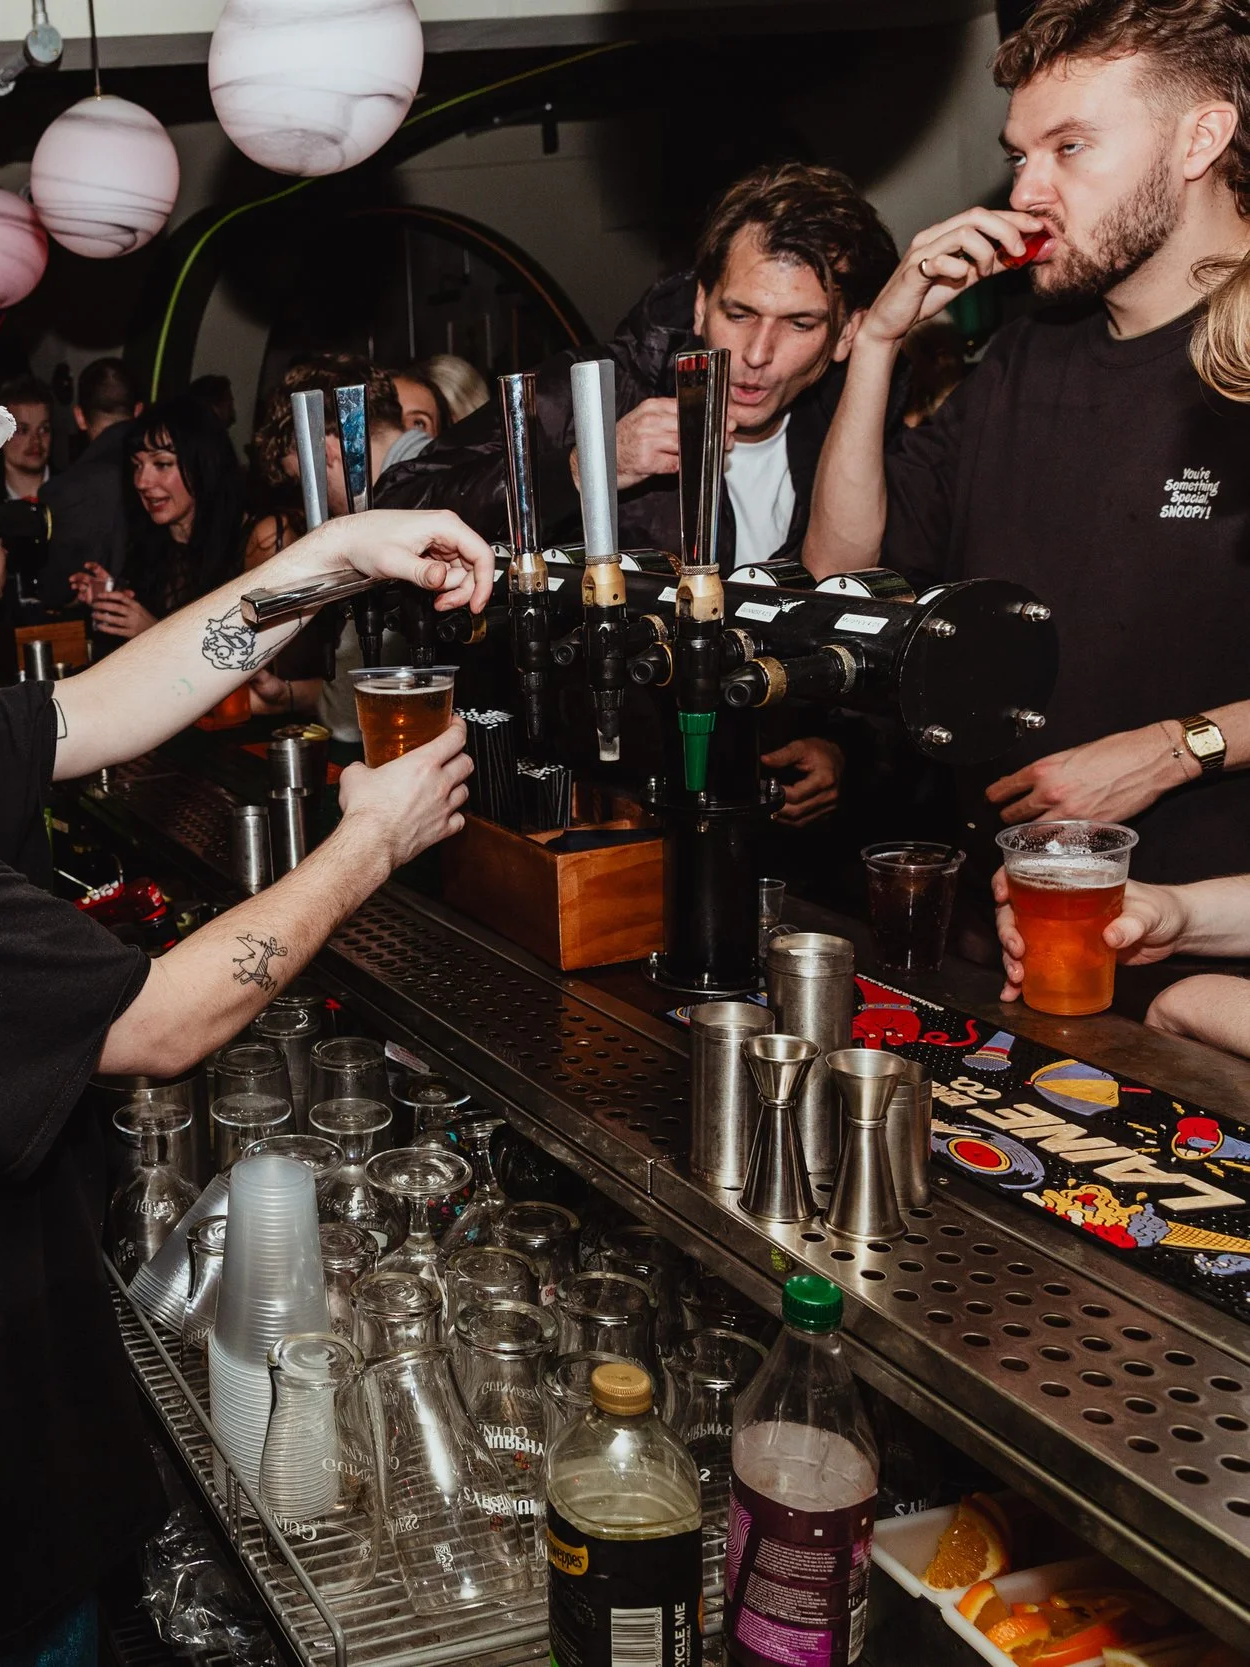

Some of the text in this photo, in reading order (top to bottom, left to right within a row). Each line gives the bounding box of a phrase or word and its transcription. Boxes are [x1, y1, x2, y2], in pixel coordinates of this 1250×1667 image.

[1182, 466, 1211, 480] You're
[1163, 479, 1221, 497] Something
[1170, 490, 1210, 506] Special,
[1159, 505, 1212, 520] SNOOPY!
[966, 1103, 1246, 1212] LAINE
[674, 1602, 686, 1628] ME
